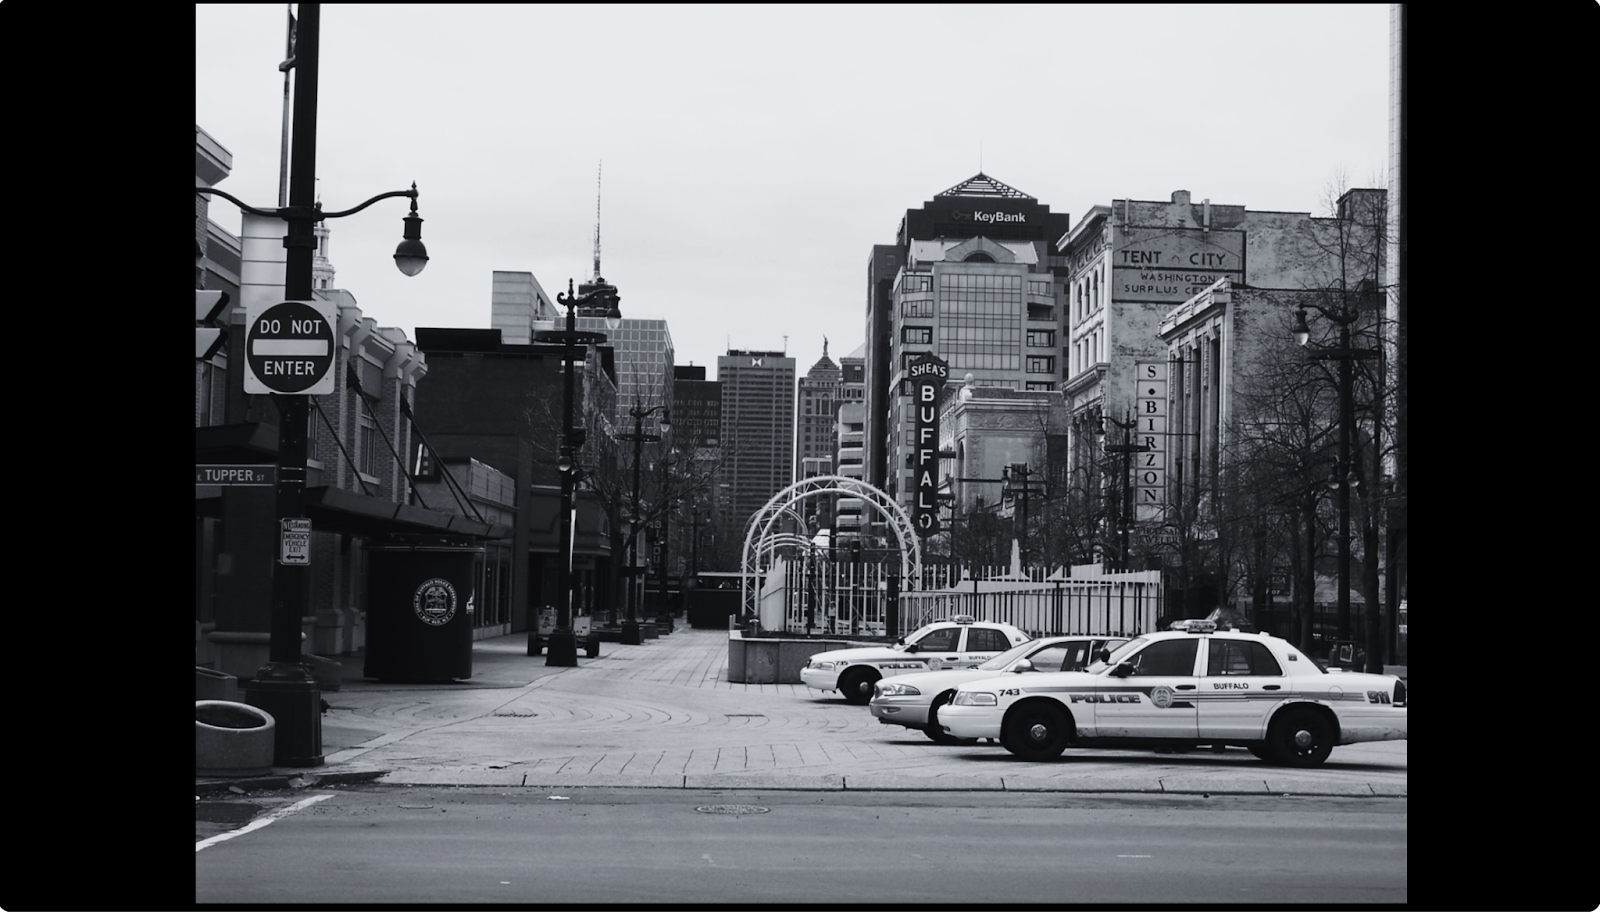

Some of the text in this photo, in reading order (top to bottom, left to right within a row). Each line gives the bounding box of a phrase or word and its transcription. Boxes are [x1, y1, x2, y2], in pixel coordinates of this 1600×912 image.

[974, 211, 1026, 224] KeyBank
[1121, 250, 1226, 266] TENT CITY
[1140, 273, 1216, 283] WASHINGTON
[1124, 284, 1178, 294] SURPLUS
[260, 319, 322, 334] DO NOT
[264, 360, 315, 376] ENTER
[911, 363, 947, 377] SHEA'S
[919, 384, 936, 529] BUFFALO
[197, 469, 265, 482] E TUPPER ST
[283, 533, 310, 541] EMERGENCY
[999, 688, 1021, 697] 743
[1213, 682, 1250, 691] BUFFALO
[1069, 694, 1142, 704] POLICE
[1367, 690, 1392, 705] 911
